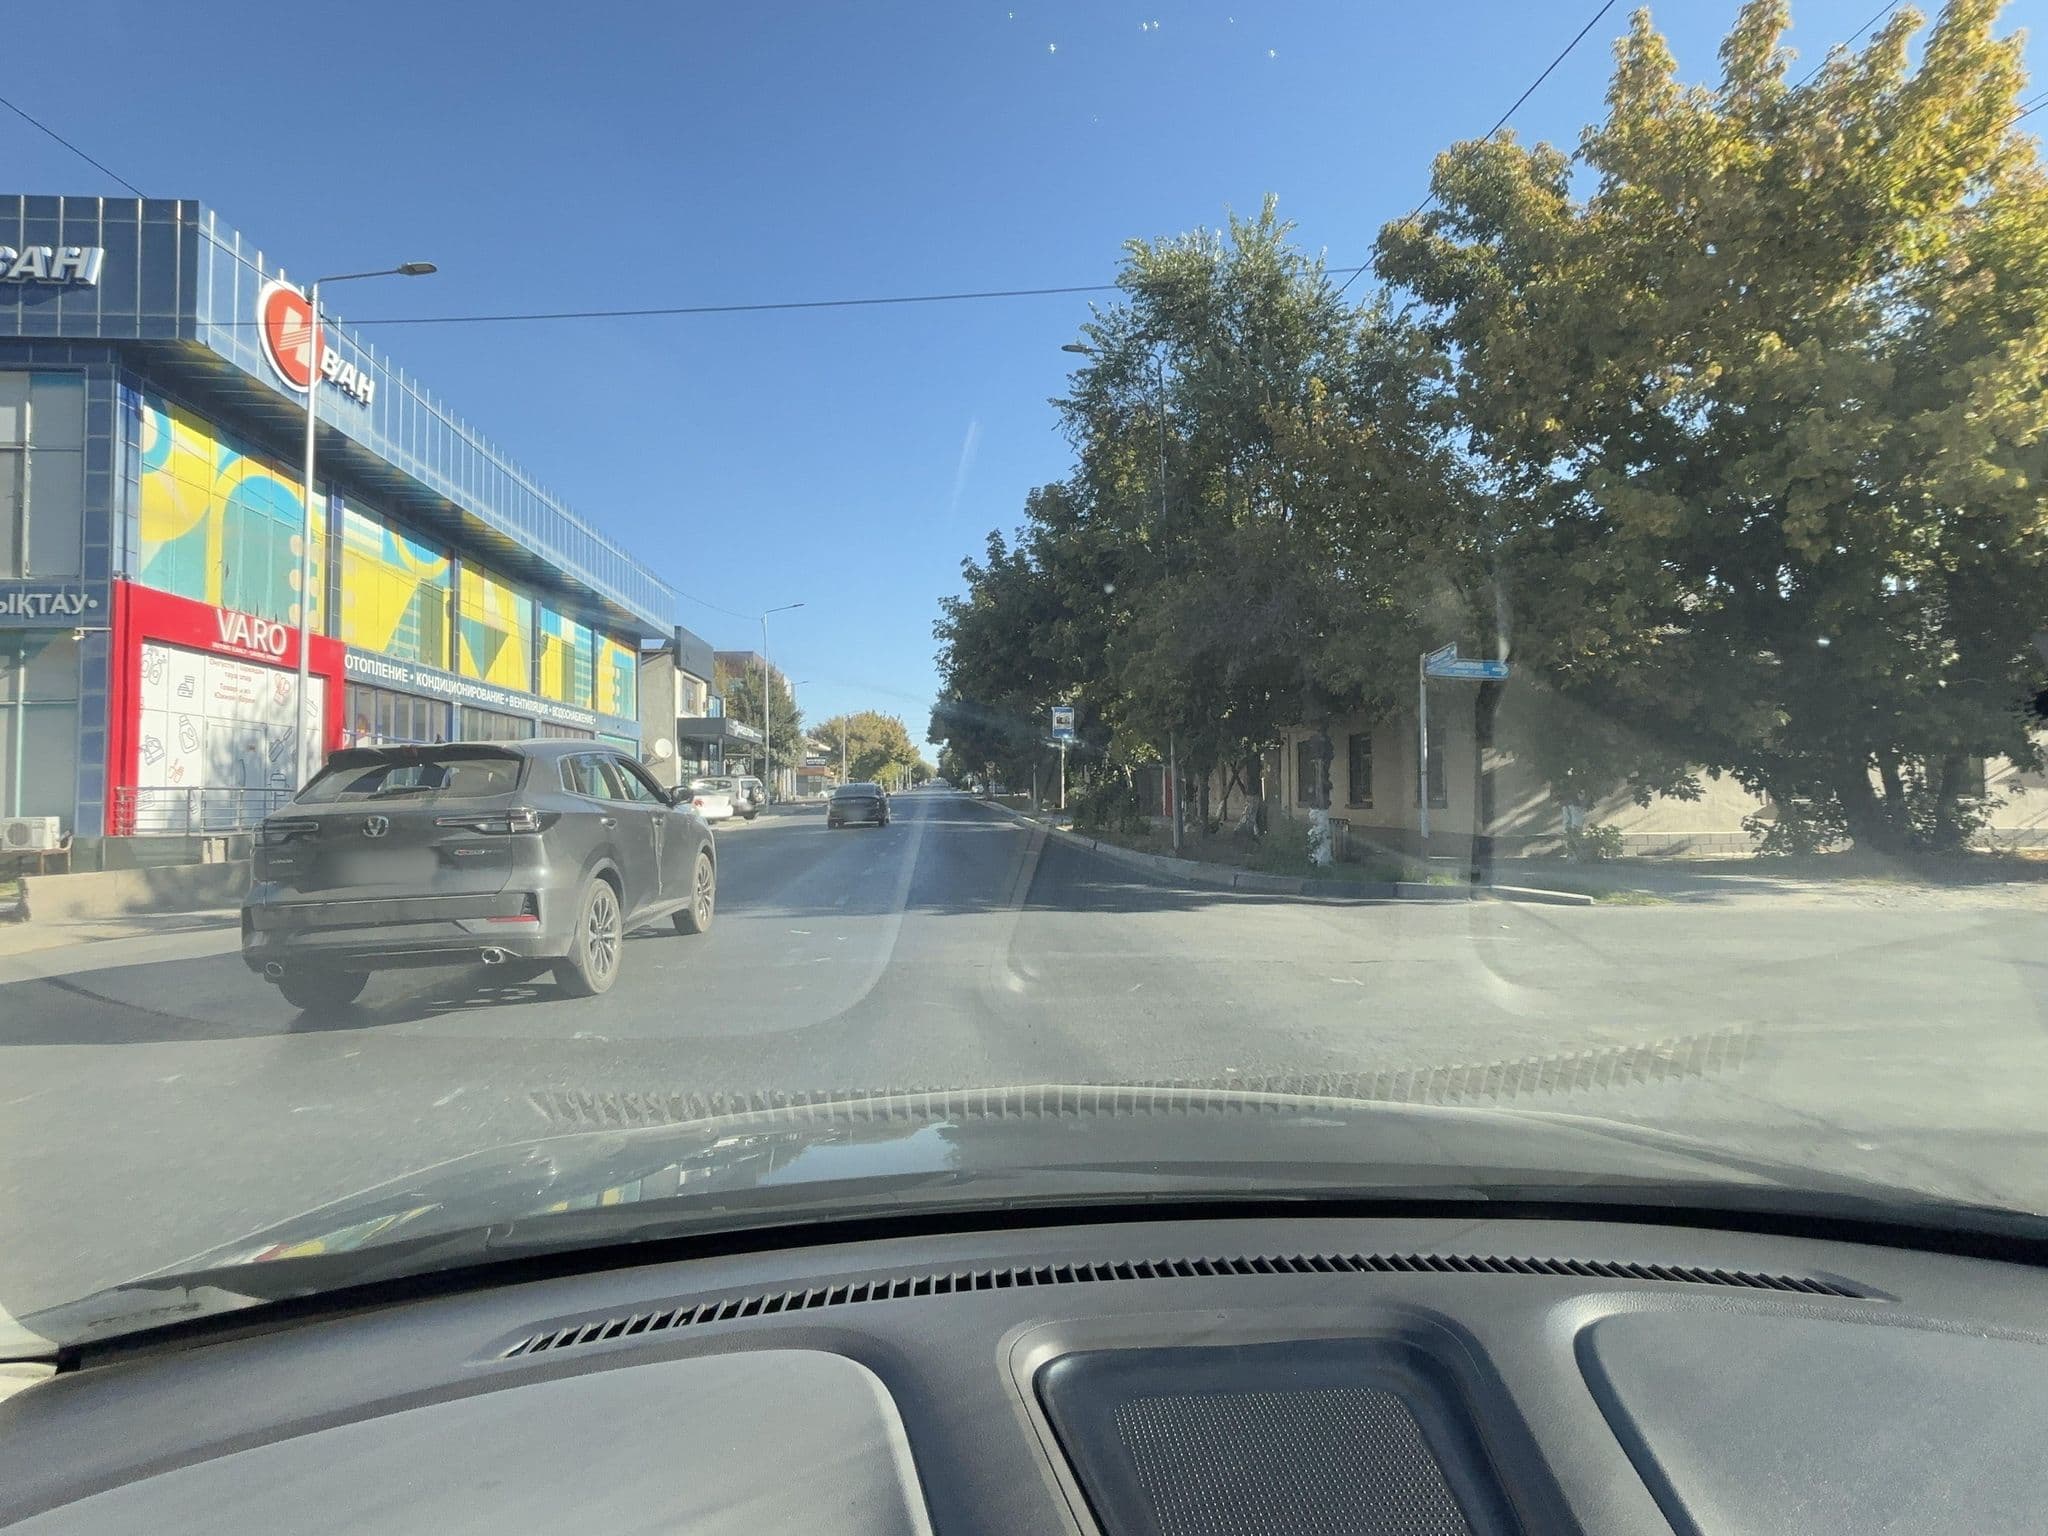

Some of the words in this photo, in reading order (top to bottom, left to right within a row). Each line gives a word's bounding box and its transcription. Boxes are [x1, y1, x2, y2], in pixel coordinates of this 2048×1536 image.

[216, 608, 287, 656] VARO
[344, 654, 408, 682] ОТОПЛЕНИЕ
[416, 672, 504, 705] КОНДИЦИОНИРОВАНИЕ
